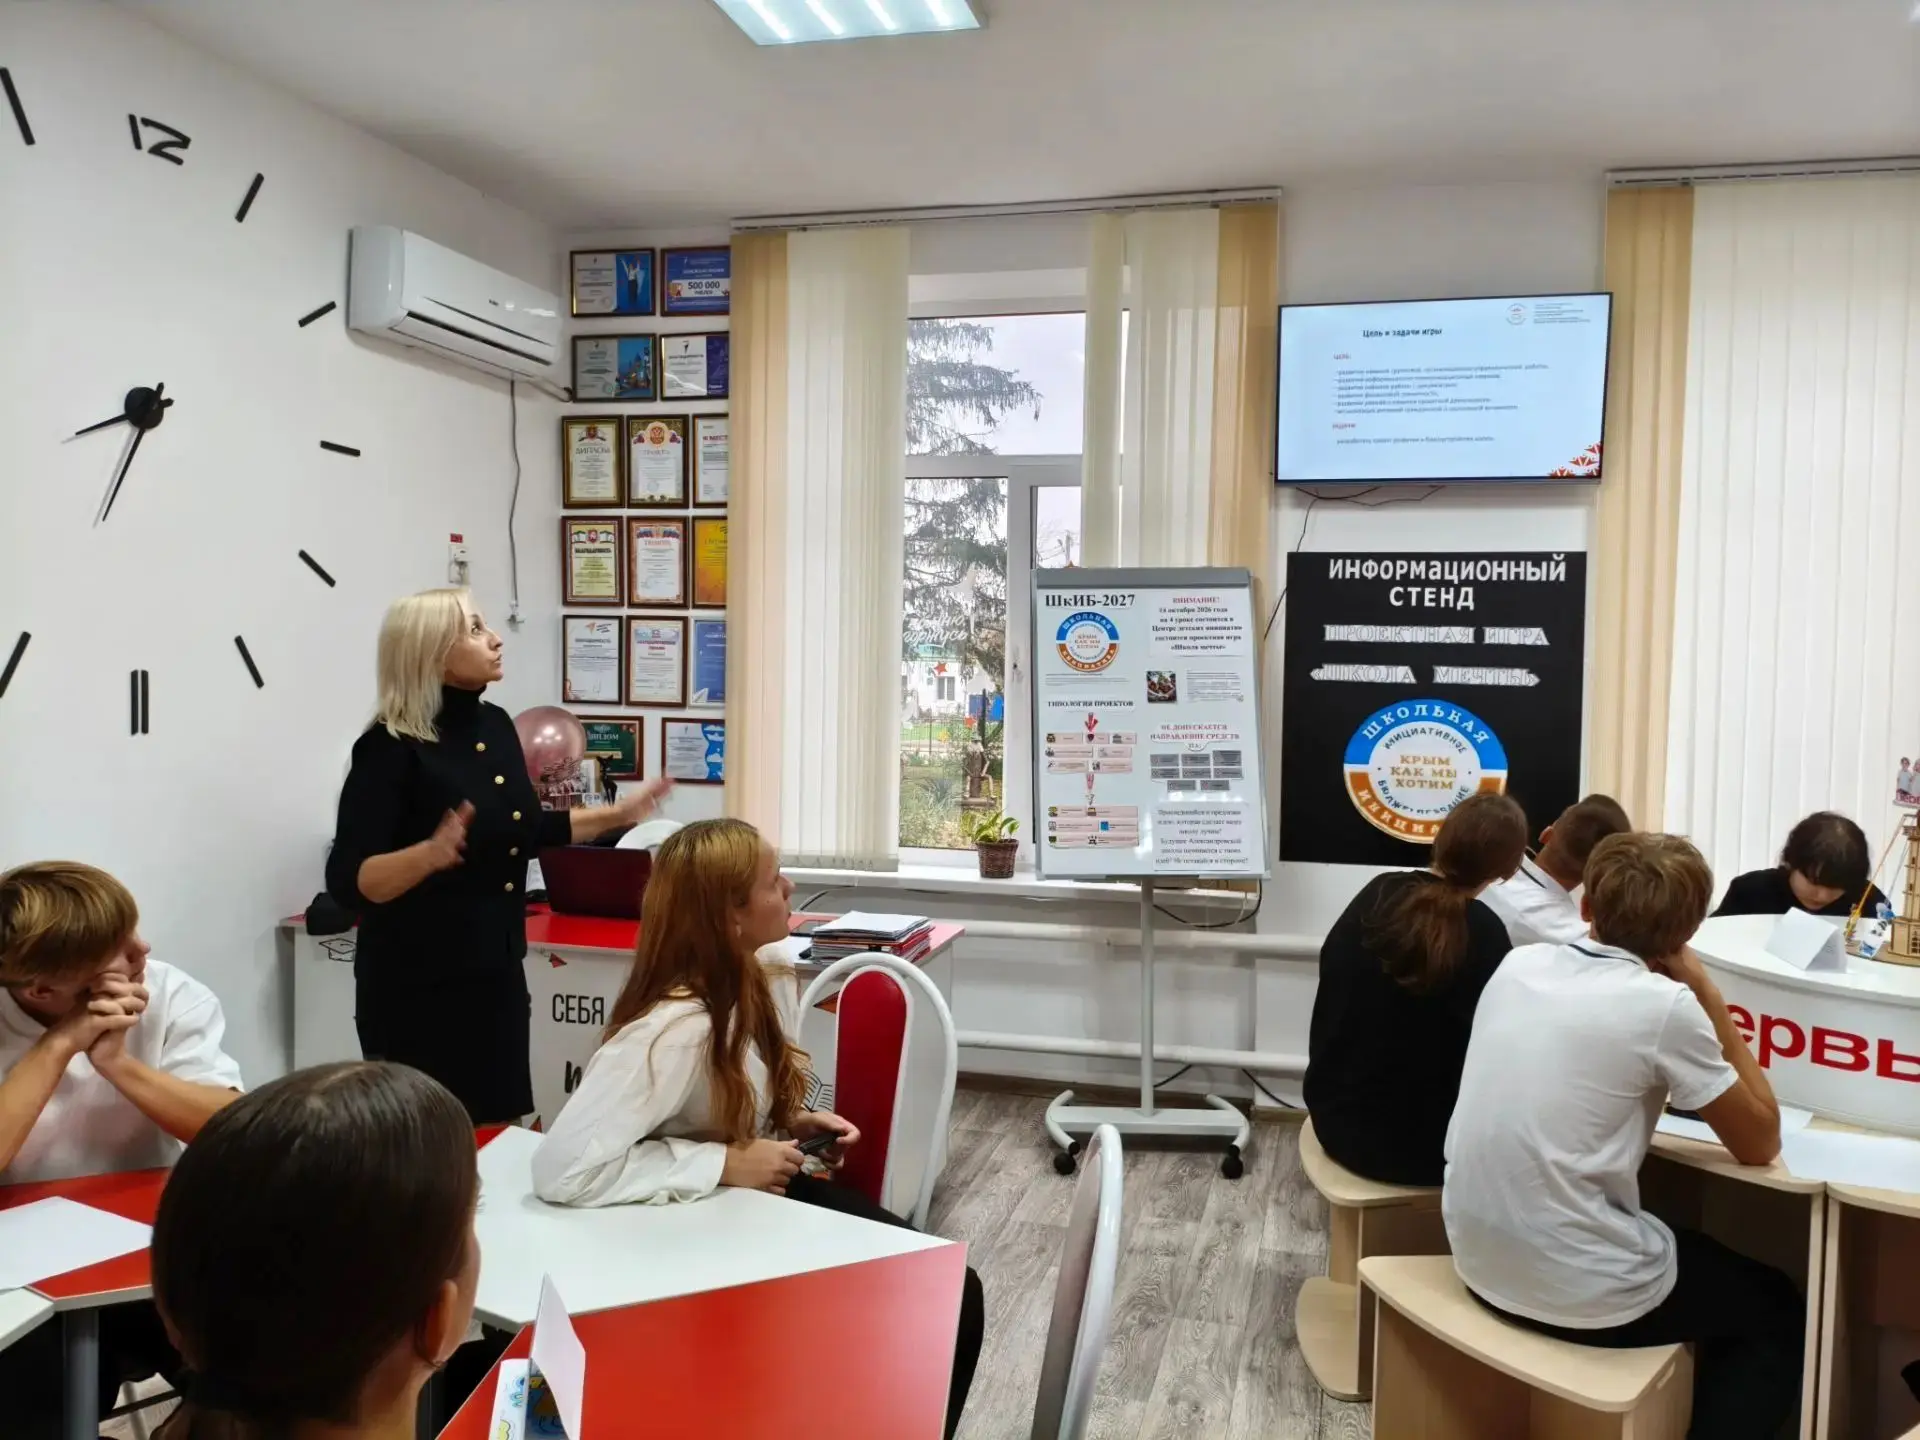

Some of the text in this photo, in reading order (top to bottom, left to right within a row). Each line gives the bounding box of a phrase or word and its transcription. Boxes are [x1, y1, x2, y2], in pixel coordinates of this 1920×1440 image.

[128, 113, 191, 166] 12
[688, 281, 720, 289] 500 000
[1362, 329, 1383, 338] Цель
[1045, 594, 1136, 607] ШкИБ-2027
[1389, 586, 1475, 611] СТЕНД
[1323, 624, 1550, 646] ПРОЕКТНАЯ ИГРА
[1361, 704, 1490, 744] ШКОЛЬНАЯ
[1400, 755, 1451, 766] КРЫМ
[1390, 766, 1457, 778] КАК МЫ
[1395, 779, 1454, 790] ХОТИМ
[552, 993, 604, 1025] СЕБЯ
